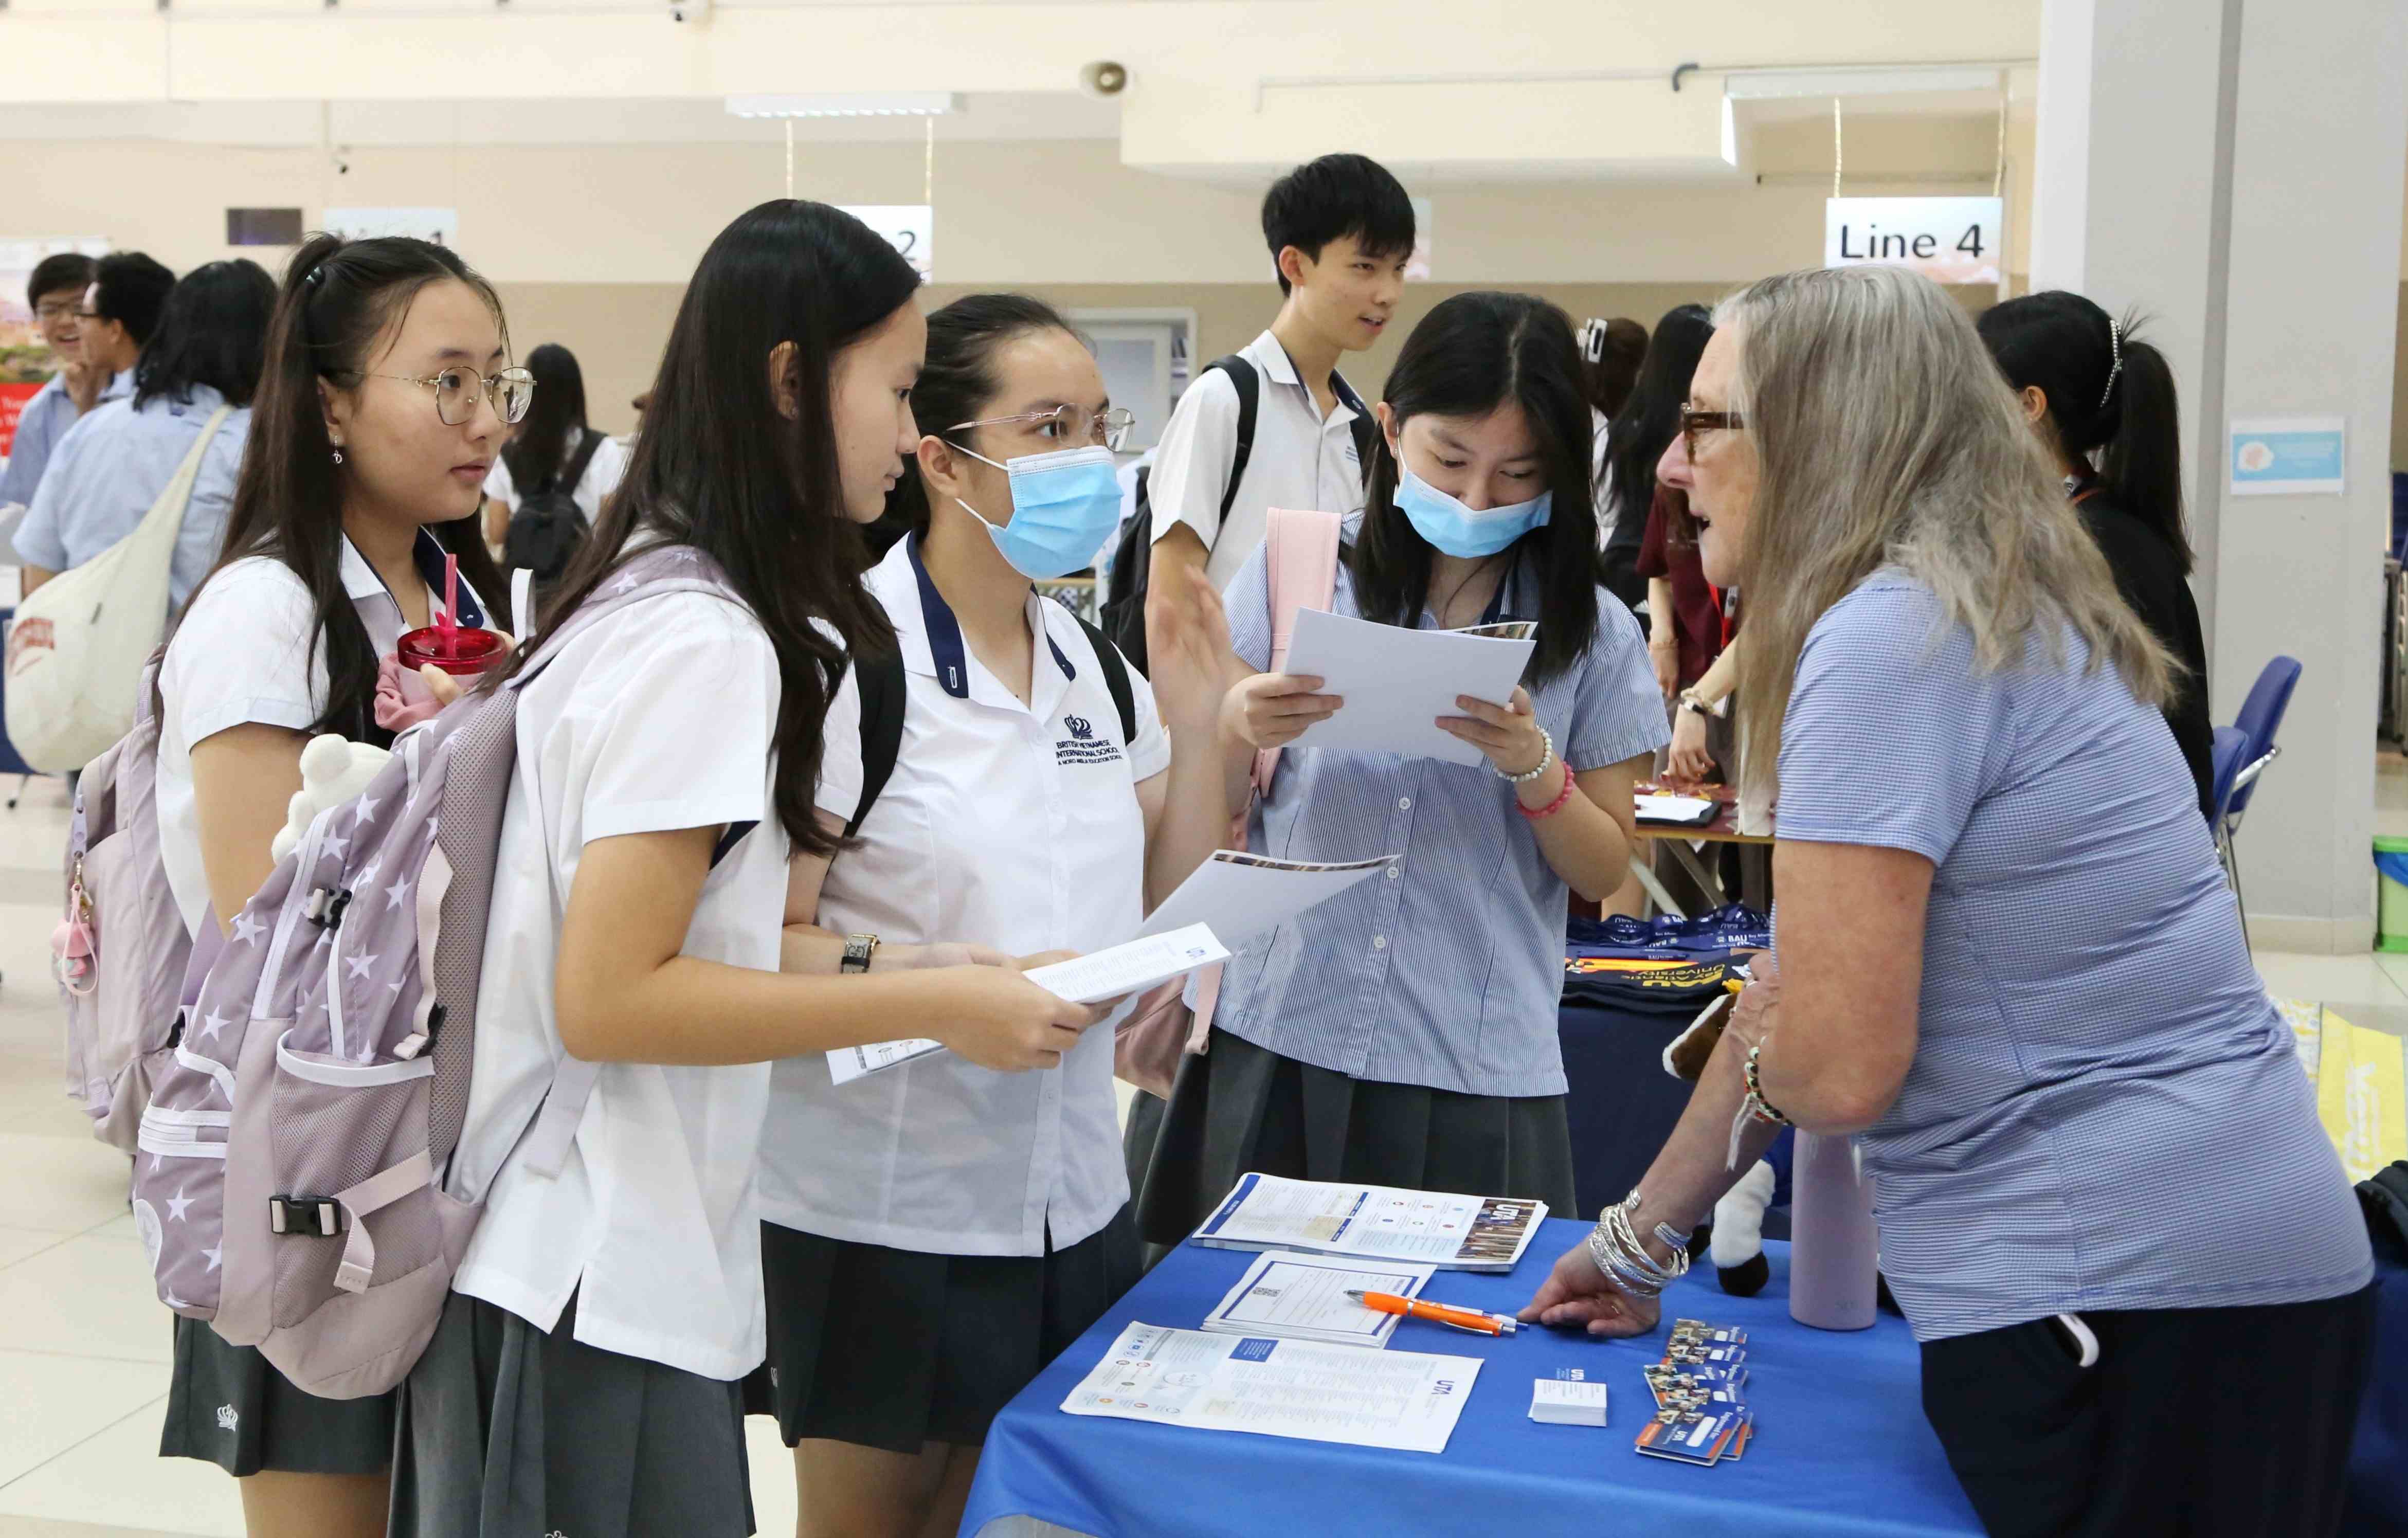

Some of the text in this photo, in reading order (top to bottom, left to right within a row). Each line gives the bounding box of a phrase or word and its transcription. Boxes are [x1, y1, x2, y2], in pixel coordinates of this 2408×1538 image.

[898, 231, 917, 261] 2
[1841, 224, 1984, 258] Line 4
[1728, 934, 1747, 942] BAU
[1490, 1204, 1521, 1220] UTA
[1431, 1380, 1455, 1395] UTA
